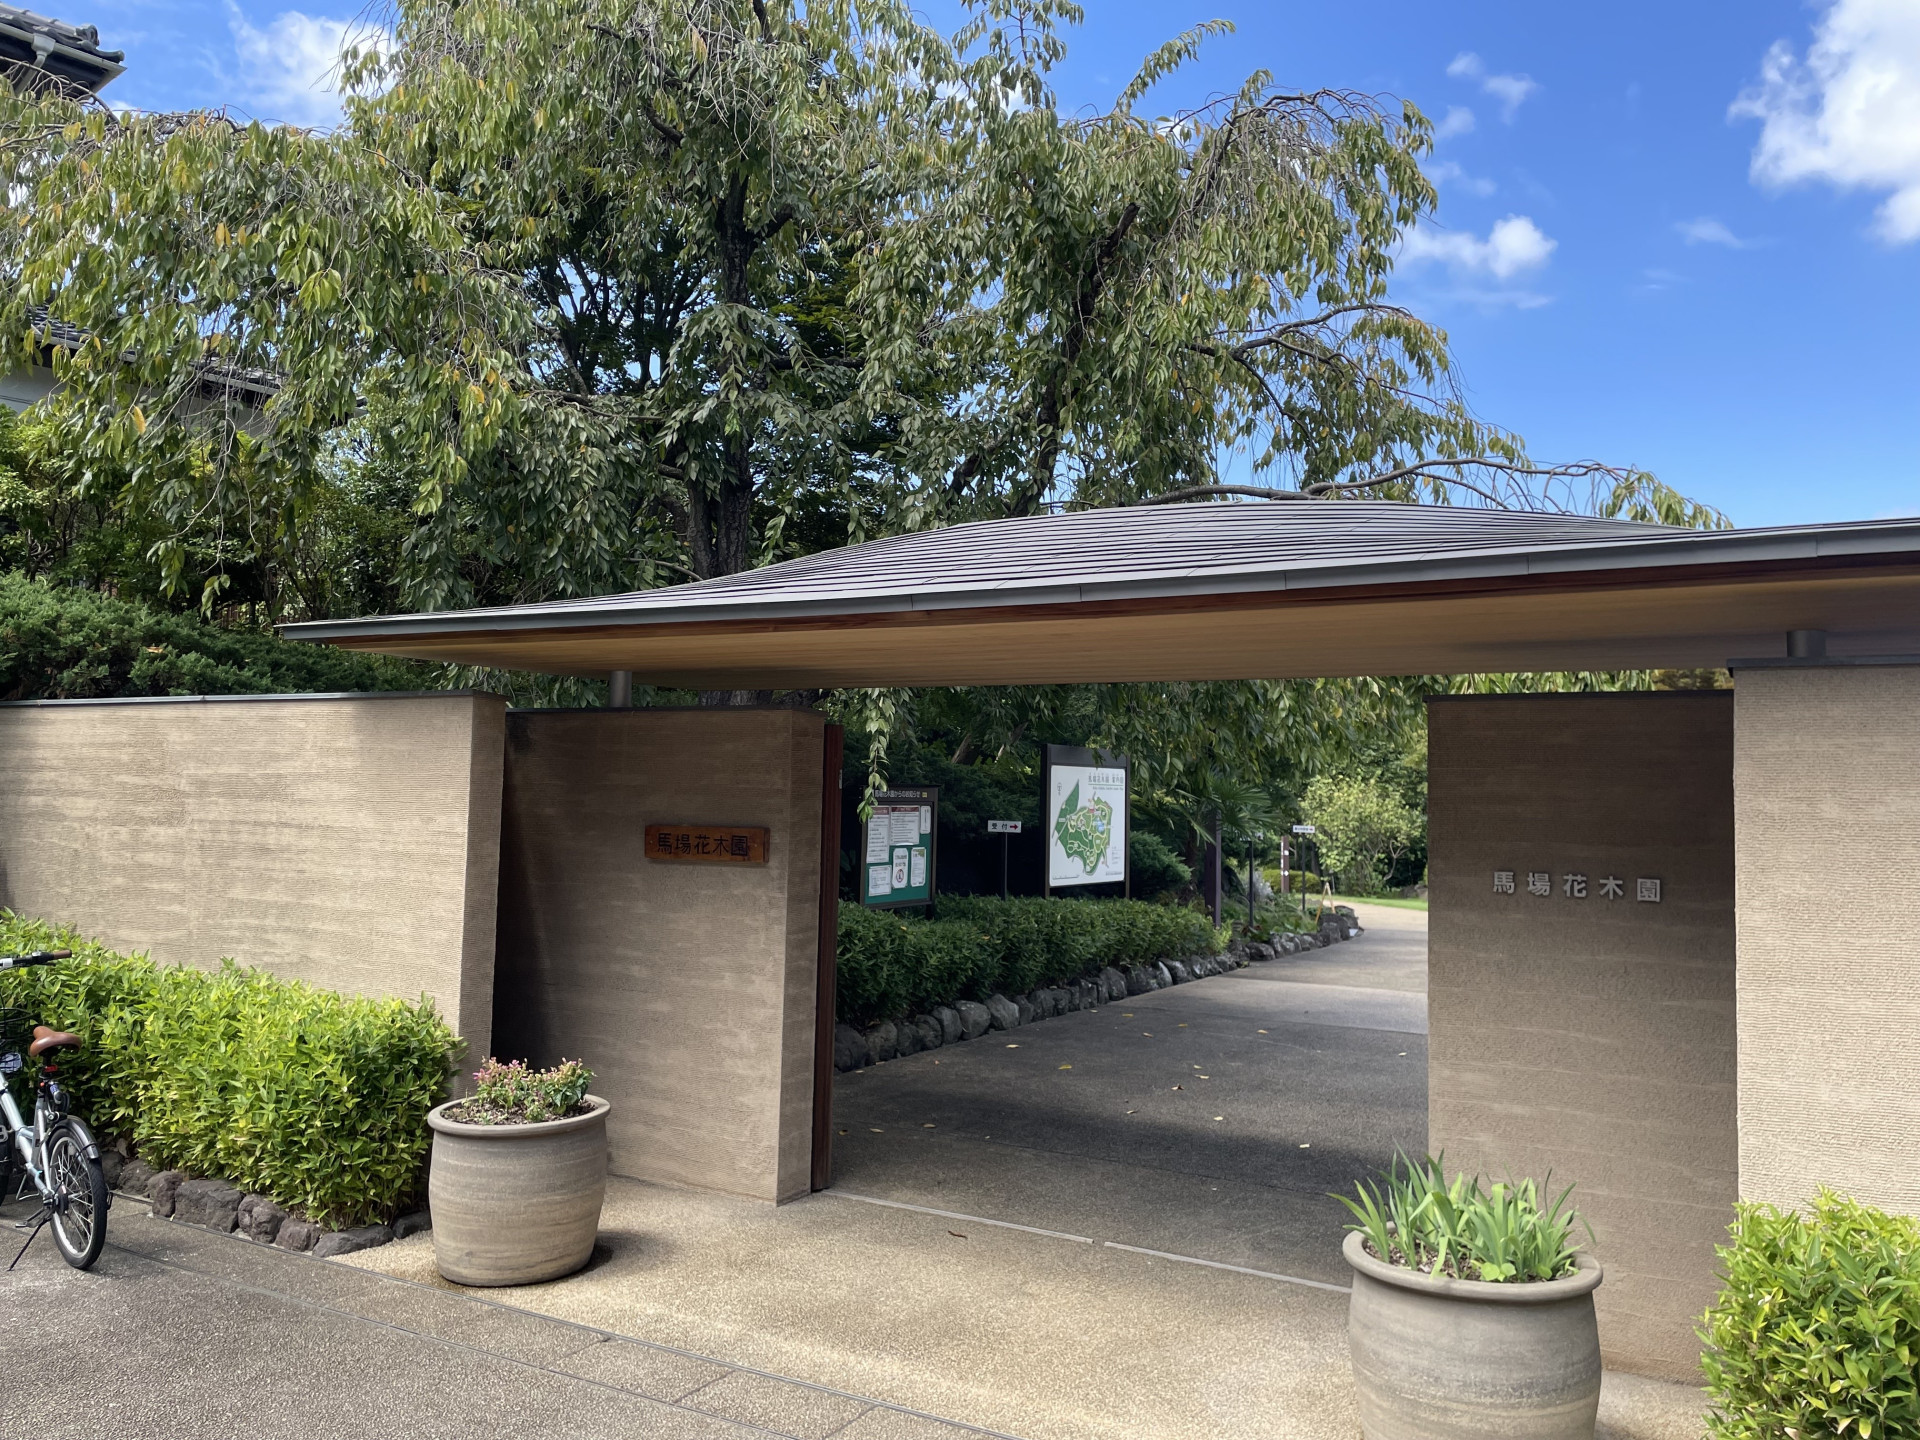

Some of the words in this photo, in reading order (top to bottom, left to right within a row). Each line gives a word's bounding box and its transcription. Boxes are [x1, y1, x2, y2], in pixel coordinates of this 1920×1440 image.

[991, 822, 1008, 831] 受付
[657, 832, 748, 857] 馬場花木園
[1493, 871, 1661, 903] 馬場花木園
